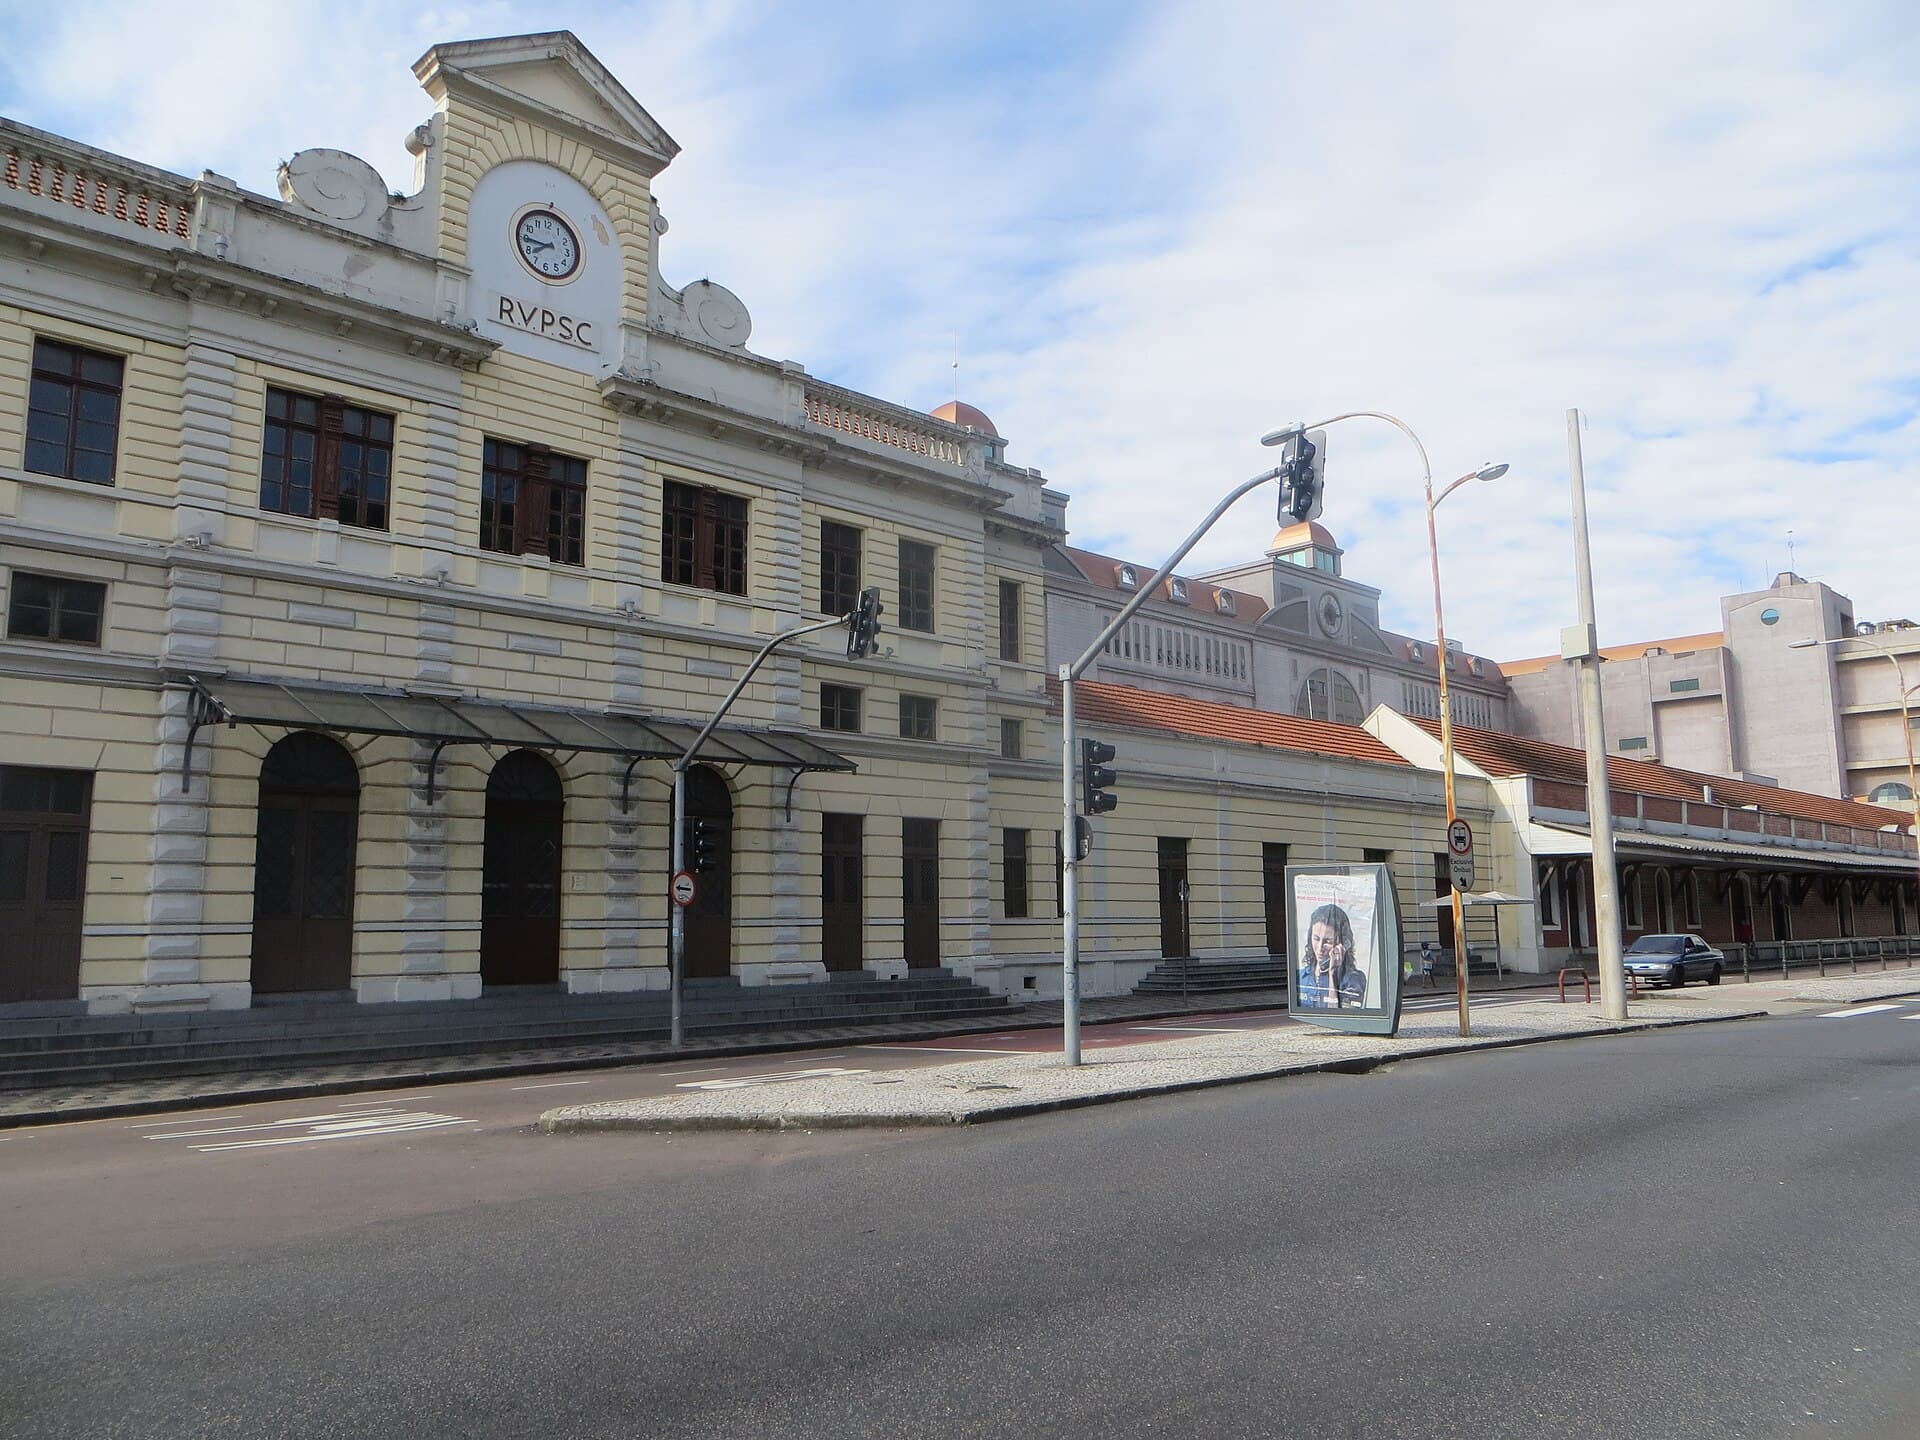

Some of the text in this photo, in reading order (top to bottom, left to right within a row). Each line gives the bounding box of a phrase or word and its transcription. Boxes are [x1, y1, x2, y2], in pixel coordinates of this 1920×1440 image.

[526, 224, 534, 234] 10
[534, 219, 541, 229] 11
[544, 219, 552, 230] 12
[562, 237, 568, 246] 2
[525, 245, 532, 255] 8
[564, 248, 570, 258] 3
[543, 262, 549, 271] 6
[553, 263, 560, 272] 5
